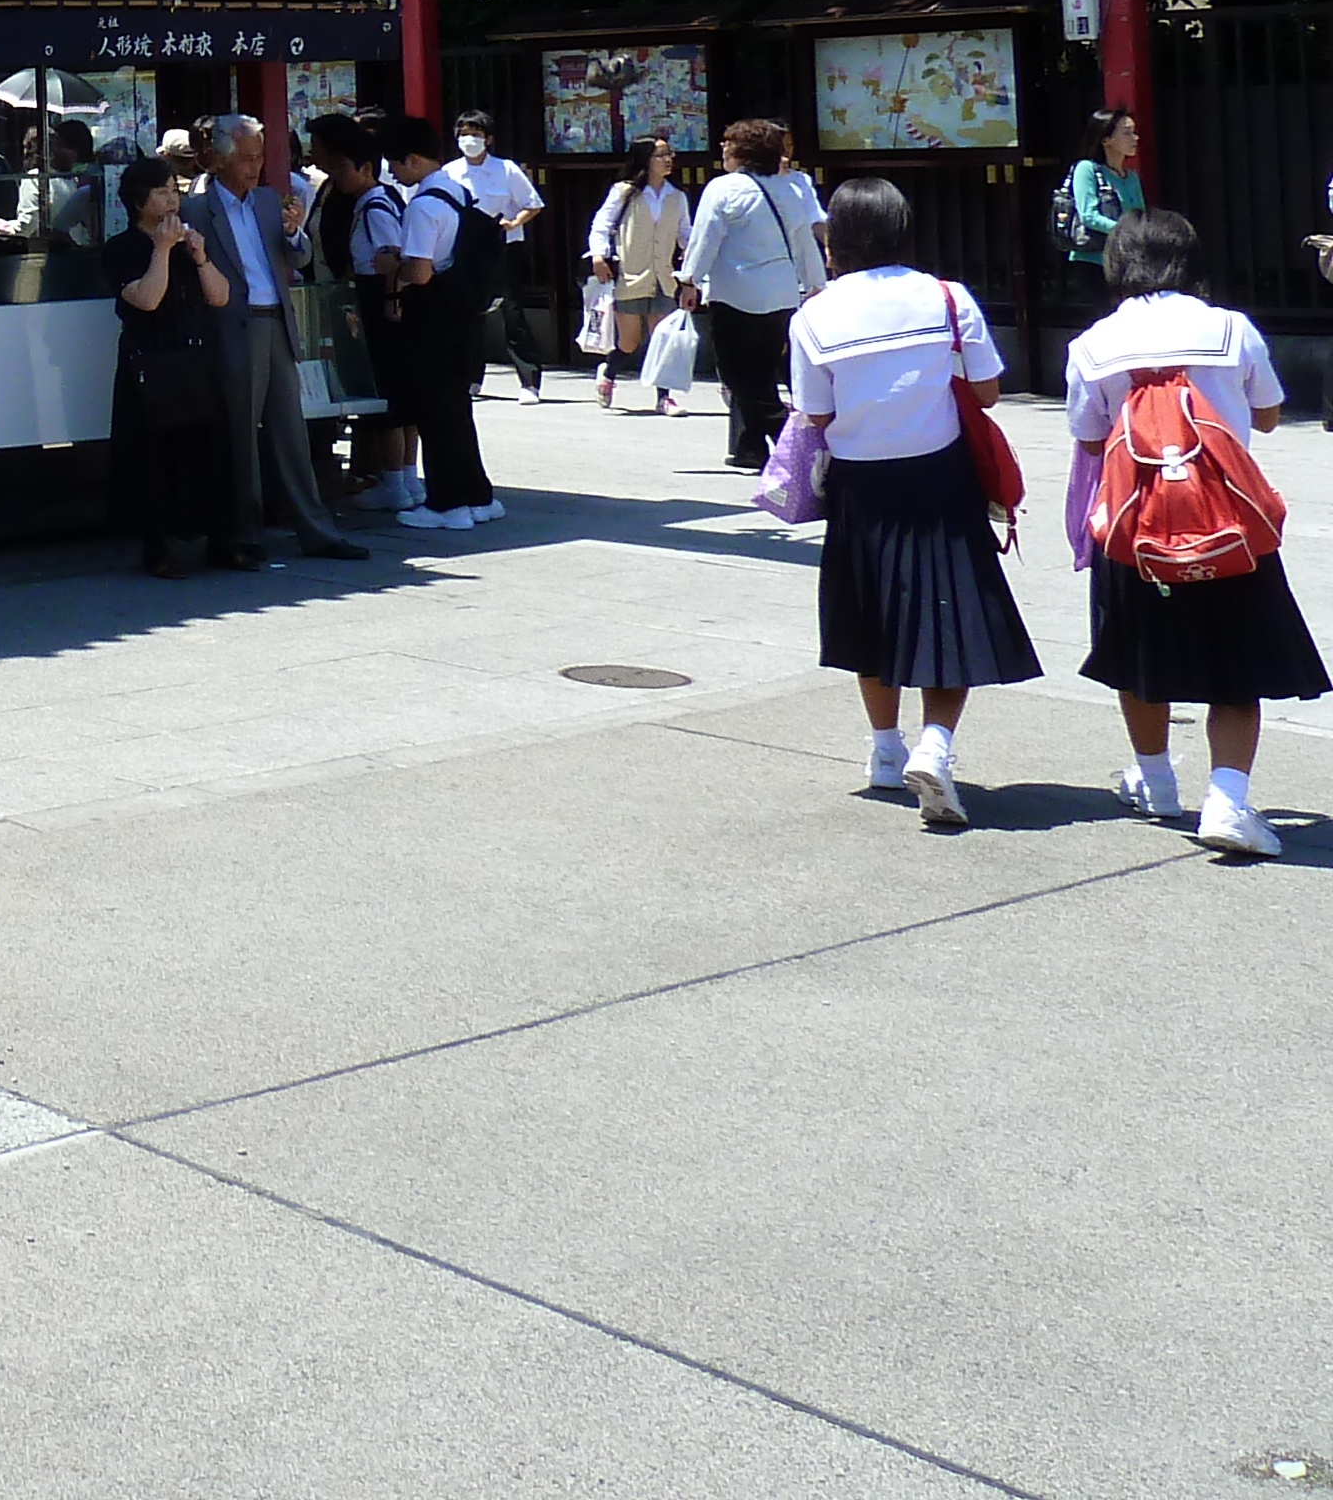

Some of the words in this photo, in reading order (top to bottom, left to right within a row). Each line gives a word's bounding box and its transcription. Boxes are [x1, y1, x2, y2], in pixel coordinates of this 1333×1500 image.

[161, 31, 213, 57] 木村家
[230, 30, 267, 57] 本店
